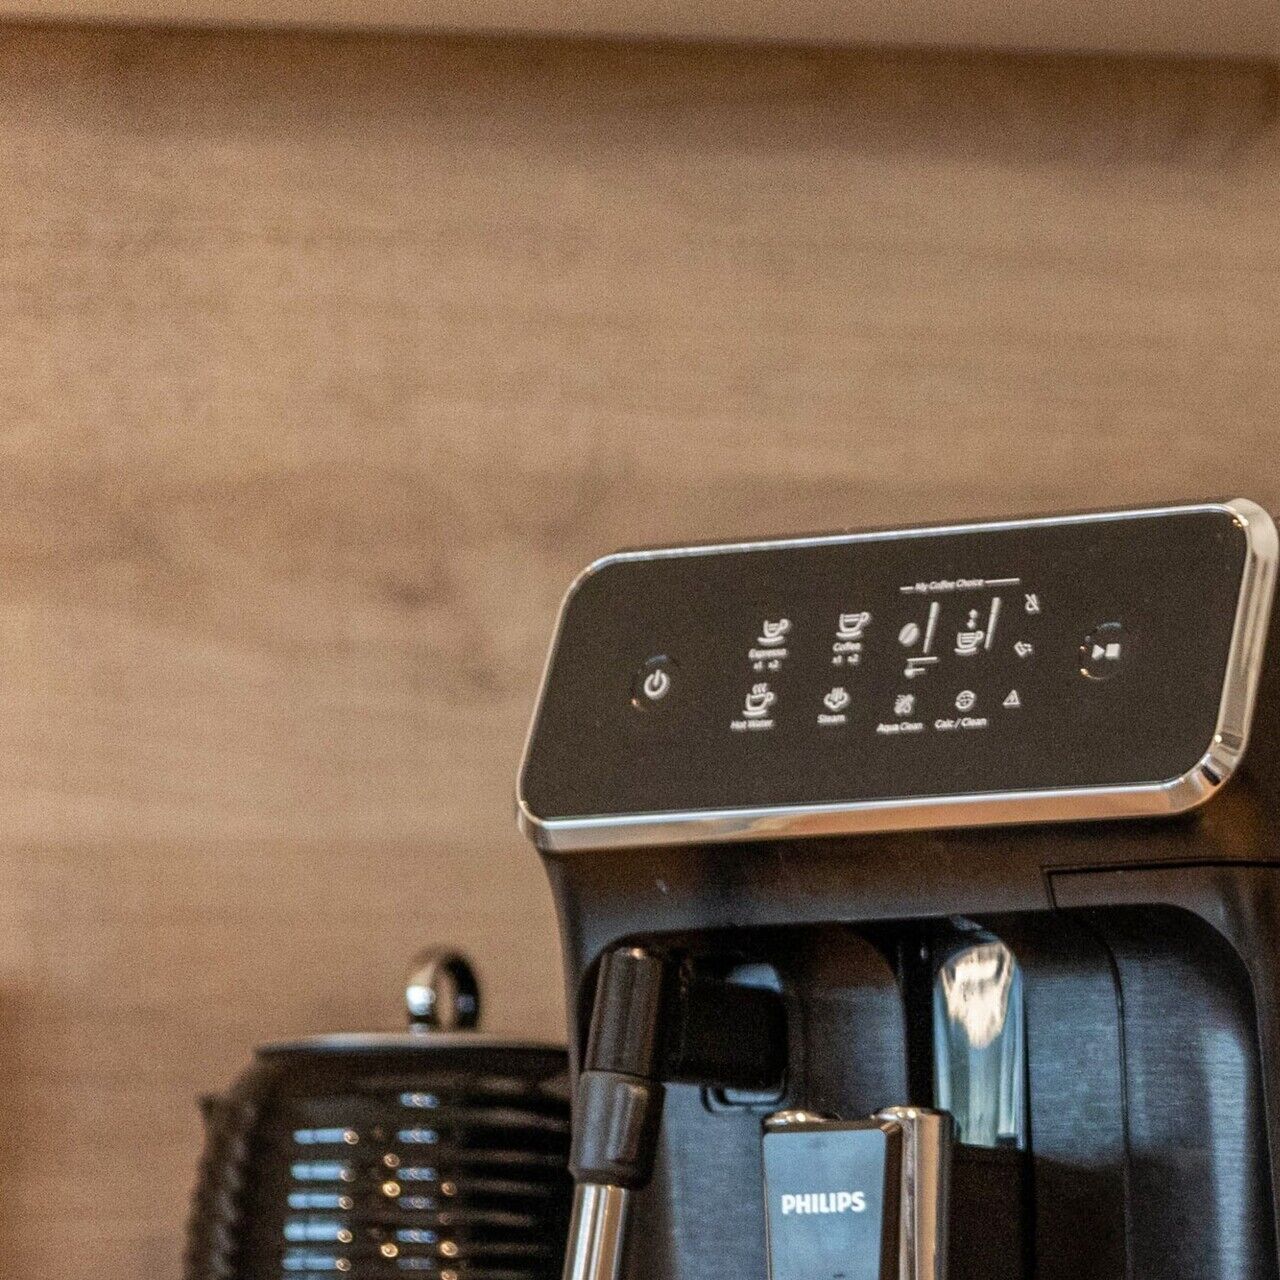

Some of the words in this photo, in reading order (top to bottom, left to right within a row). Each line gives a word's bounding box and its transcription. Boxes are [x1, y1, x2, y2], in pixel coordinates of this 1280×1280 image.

[929, 580, 956, 591] Coffee
[832, 641, 863, 652] Coffee
[748, 648, 788, 660] Espresso
[817, 714, 846, 724] Steam
[730, 720, 747, 731] Hot
[747, 719, 773, 730] Water
[781, 1190, 866, 1215] PHILIPS
